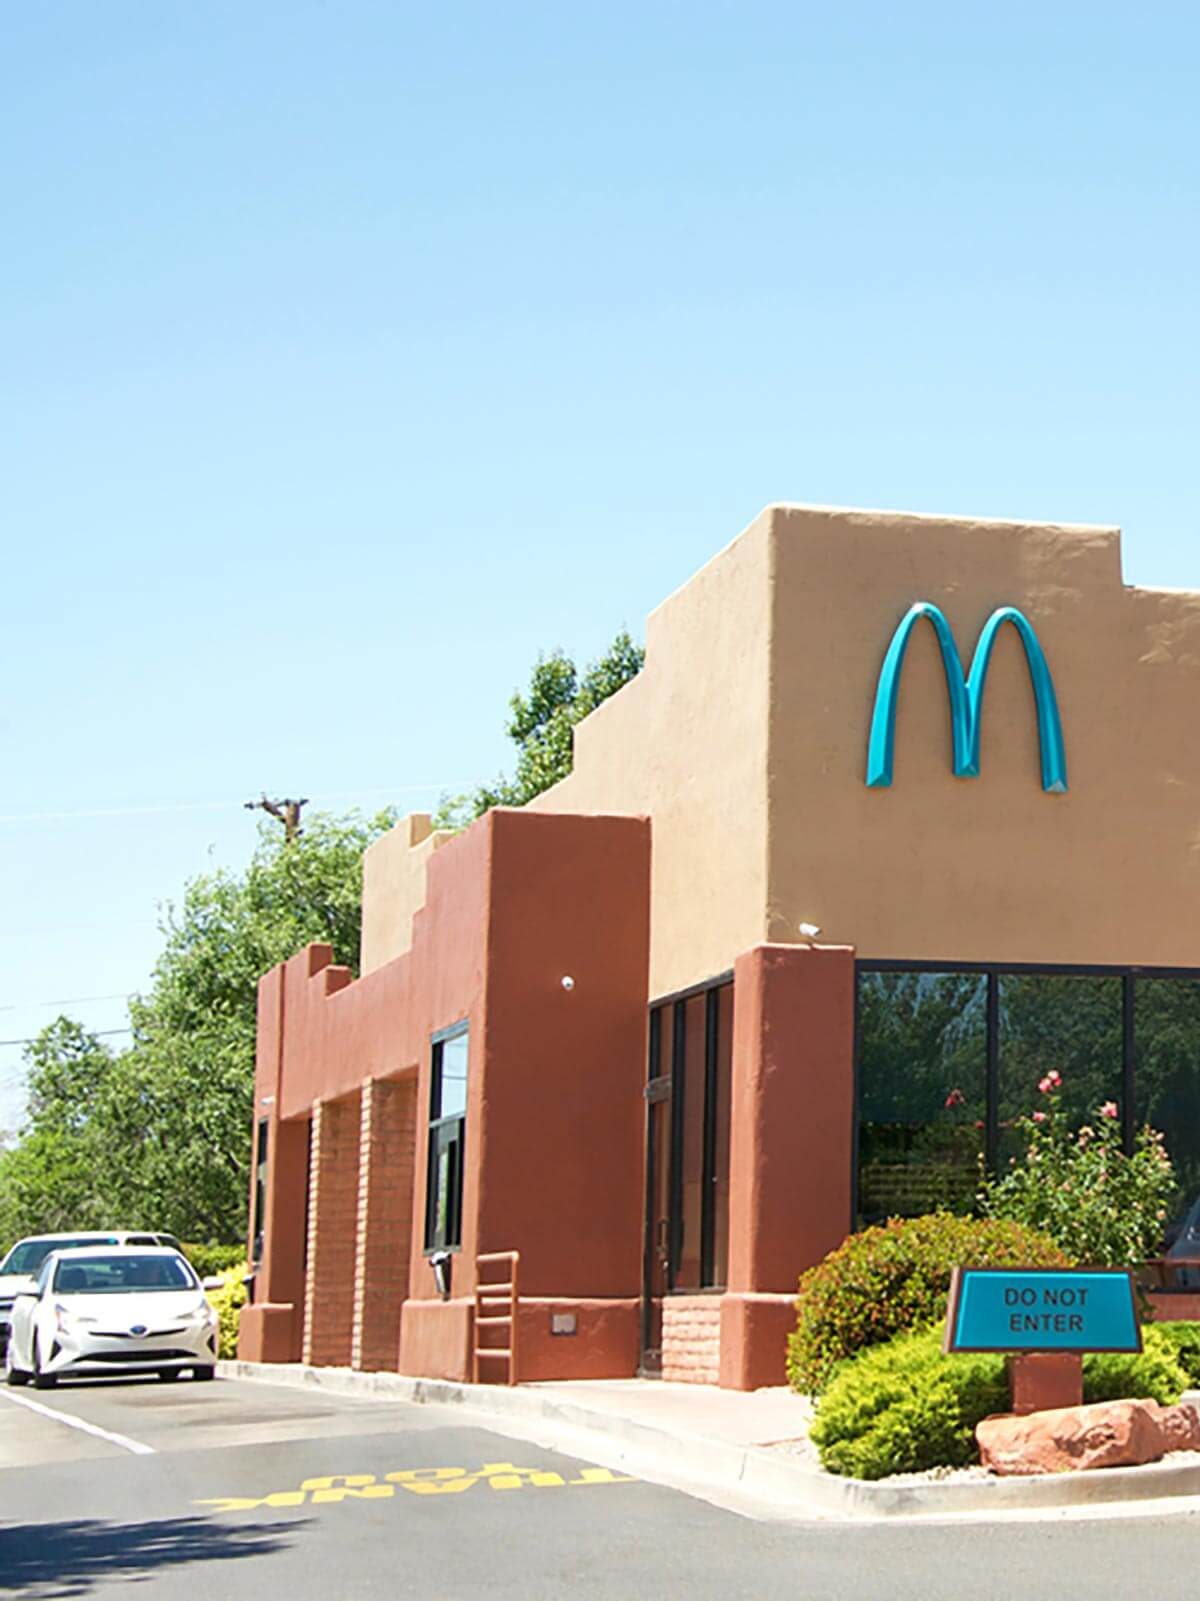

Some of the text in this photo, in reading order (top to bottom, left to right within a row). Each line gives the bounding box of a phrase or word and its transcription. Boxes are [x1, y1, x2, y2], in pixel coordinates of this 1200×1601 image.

[866, 602, 1069, 794] M
[1004, 1287, 1088, 1306] DO NOT
[1009, 1313, 1084, 1332] ENTER
[192, 1468, 638, 1511] THANK
[301, 1463, 541, 1490] YOU
